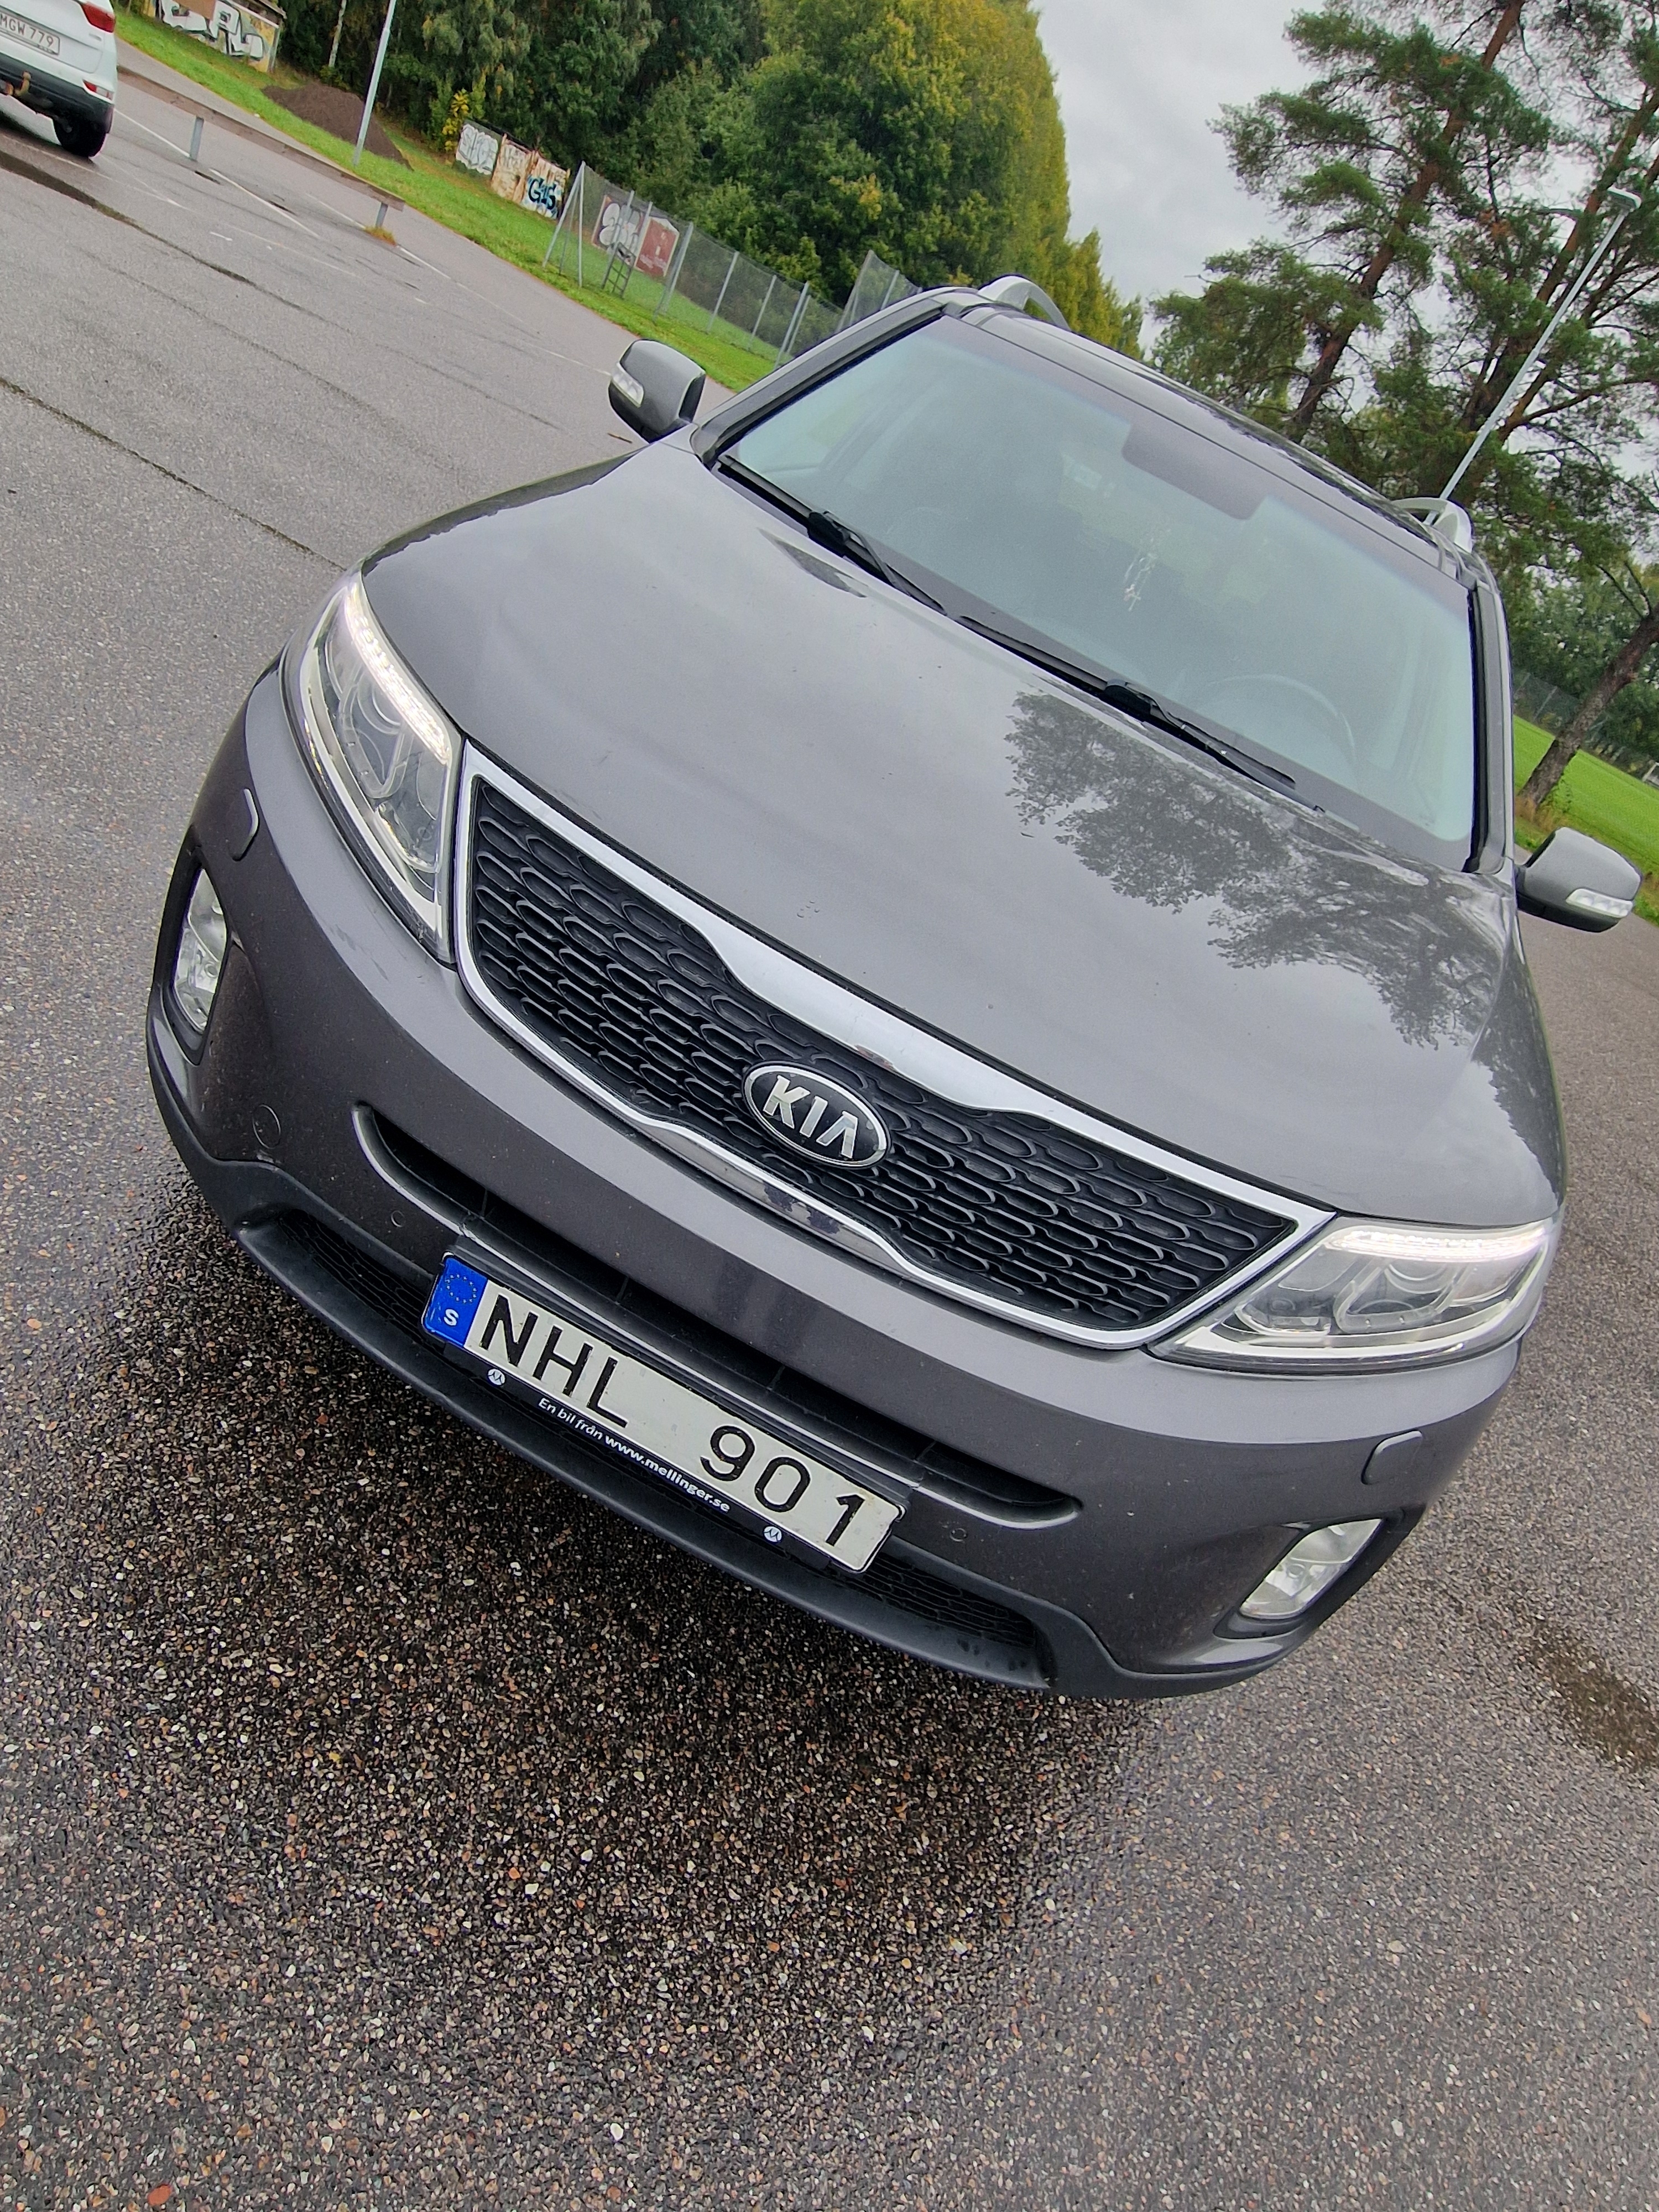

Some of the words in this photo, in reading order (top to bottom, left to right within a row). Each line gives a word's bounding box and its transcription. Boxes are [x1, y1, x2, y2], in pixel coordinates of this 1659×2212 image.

[0, 13, 25, 35] MGW
[29, 27, 54, 47] 779
[763, 1075, 858, 1159] KIA
[444, 1308, 459, 1326] S
[479, 1294, 628, 1428] NHL
[700, 1425, 865, 1547] 901
[538, 1397, 556, 1414] En
[557, 1408, 577, 1425] bil
[575, 1419, 603, 1440] från
[605, 1436, 731, 1513] www.mellinger.se
